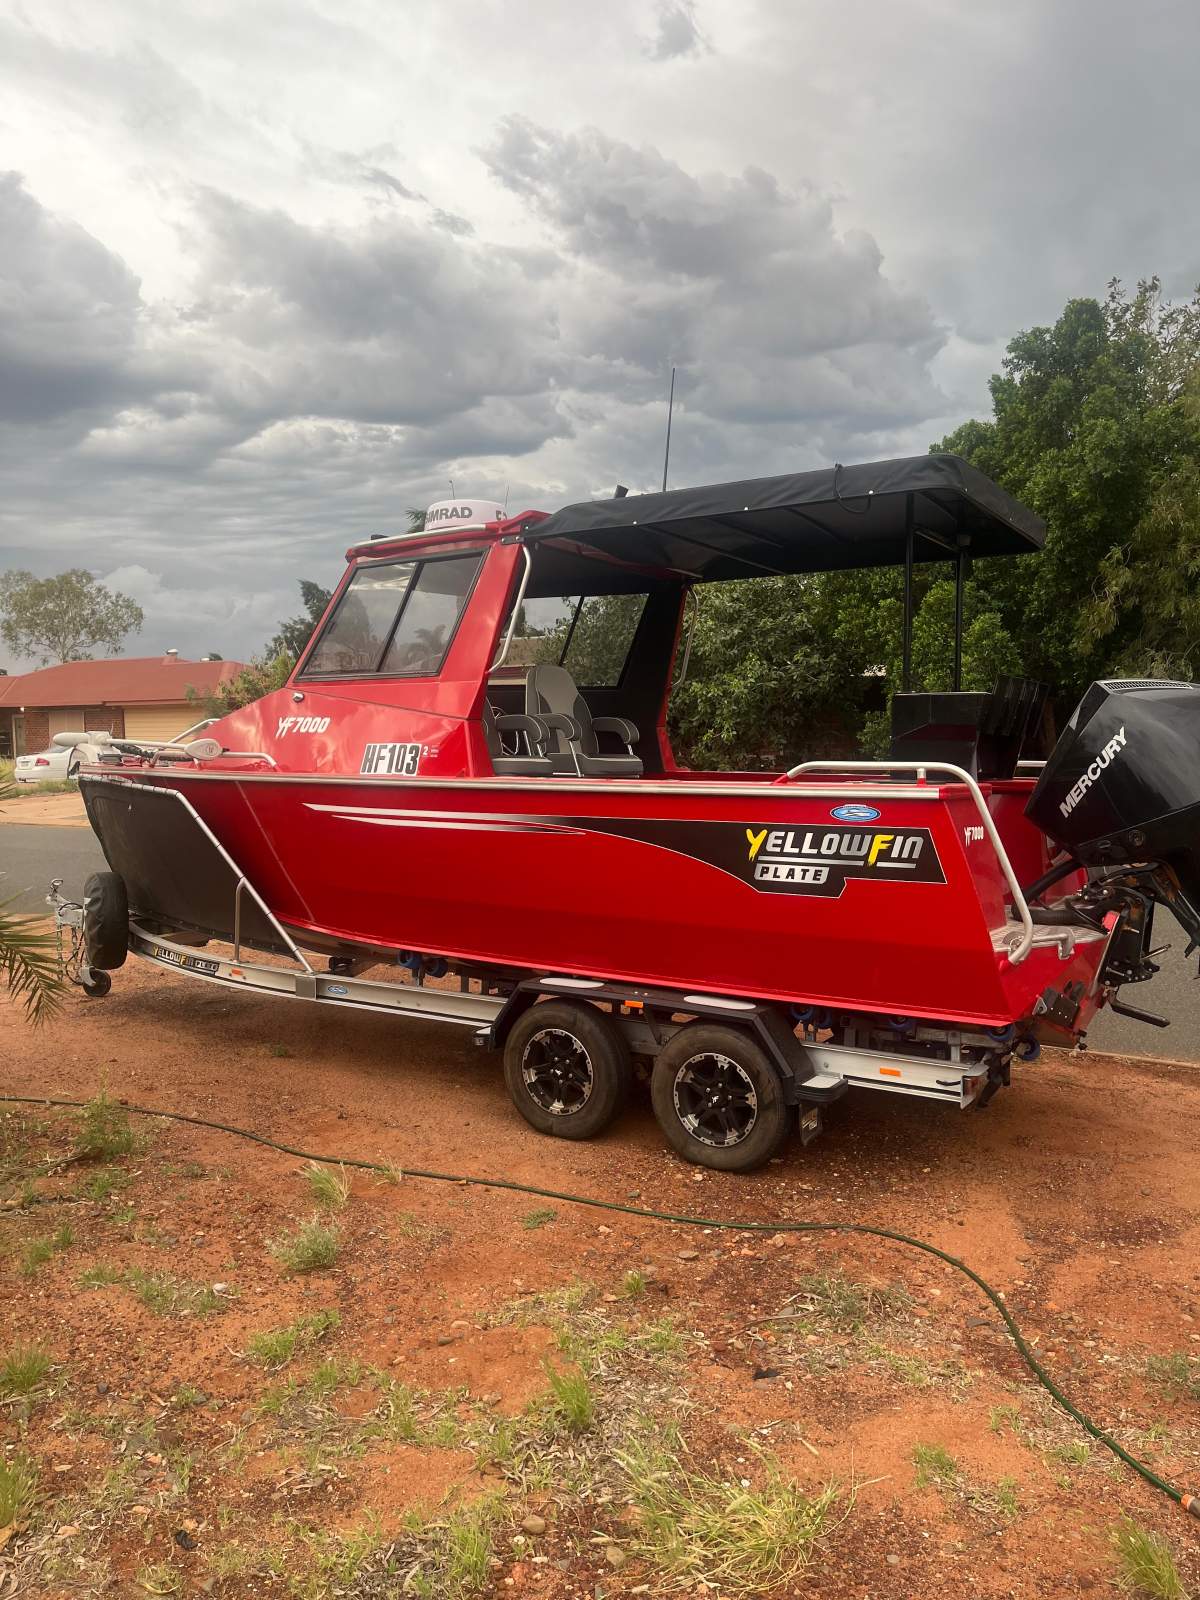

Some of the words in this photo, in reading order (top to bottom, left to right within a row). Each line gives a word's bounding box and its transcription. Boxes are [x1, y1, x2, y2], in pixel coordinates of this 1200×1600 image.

[275, 716, 331, 739] YF7000
[361, 744, 420, 775] HF103
[1059, 726, 1127, 818] MERCURY
[746, 828, 924, 867] YELLOWFIN
[759, 866, 824, 882] PLATE
